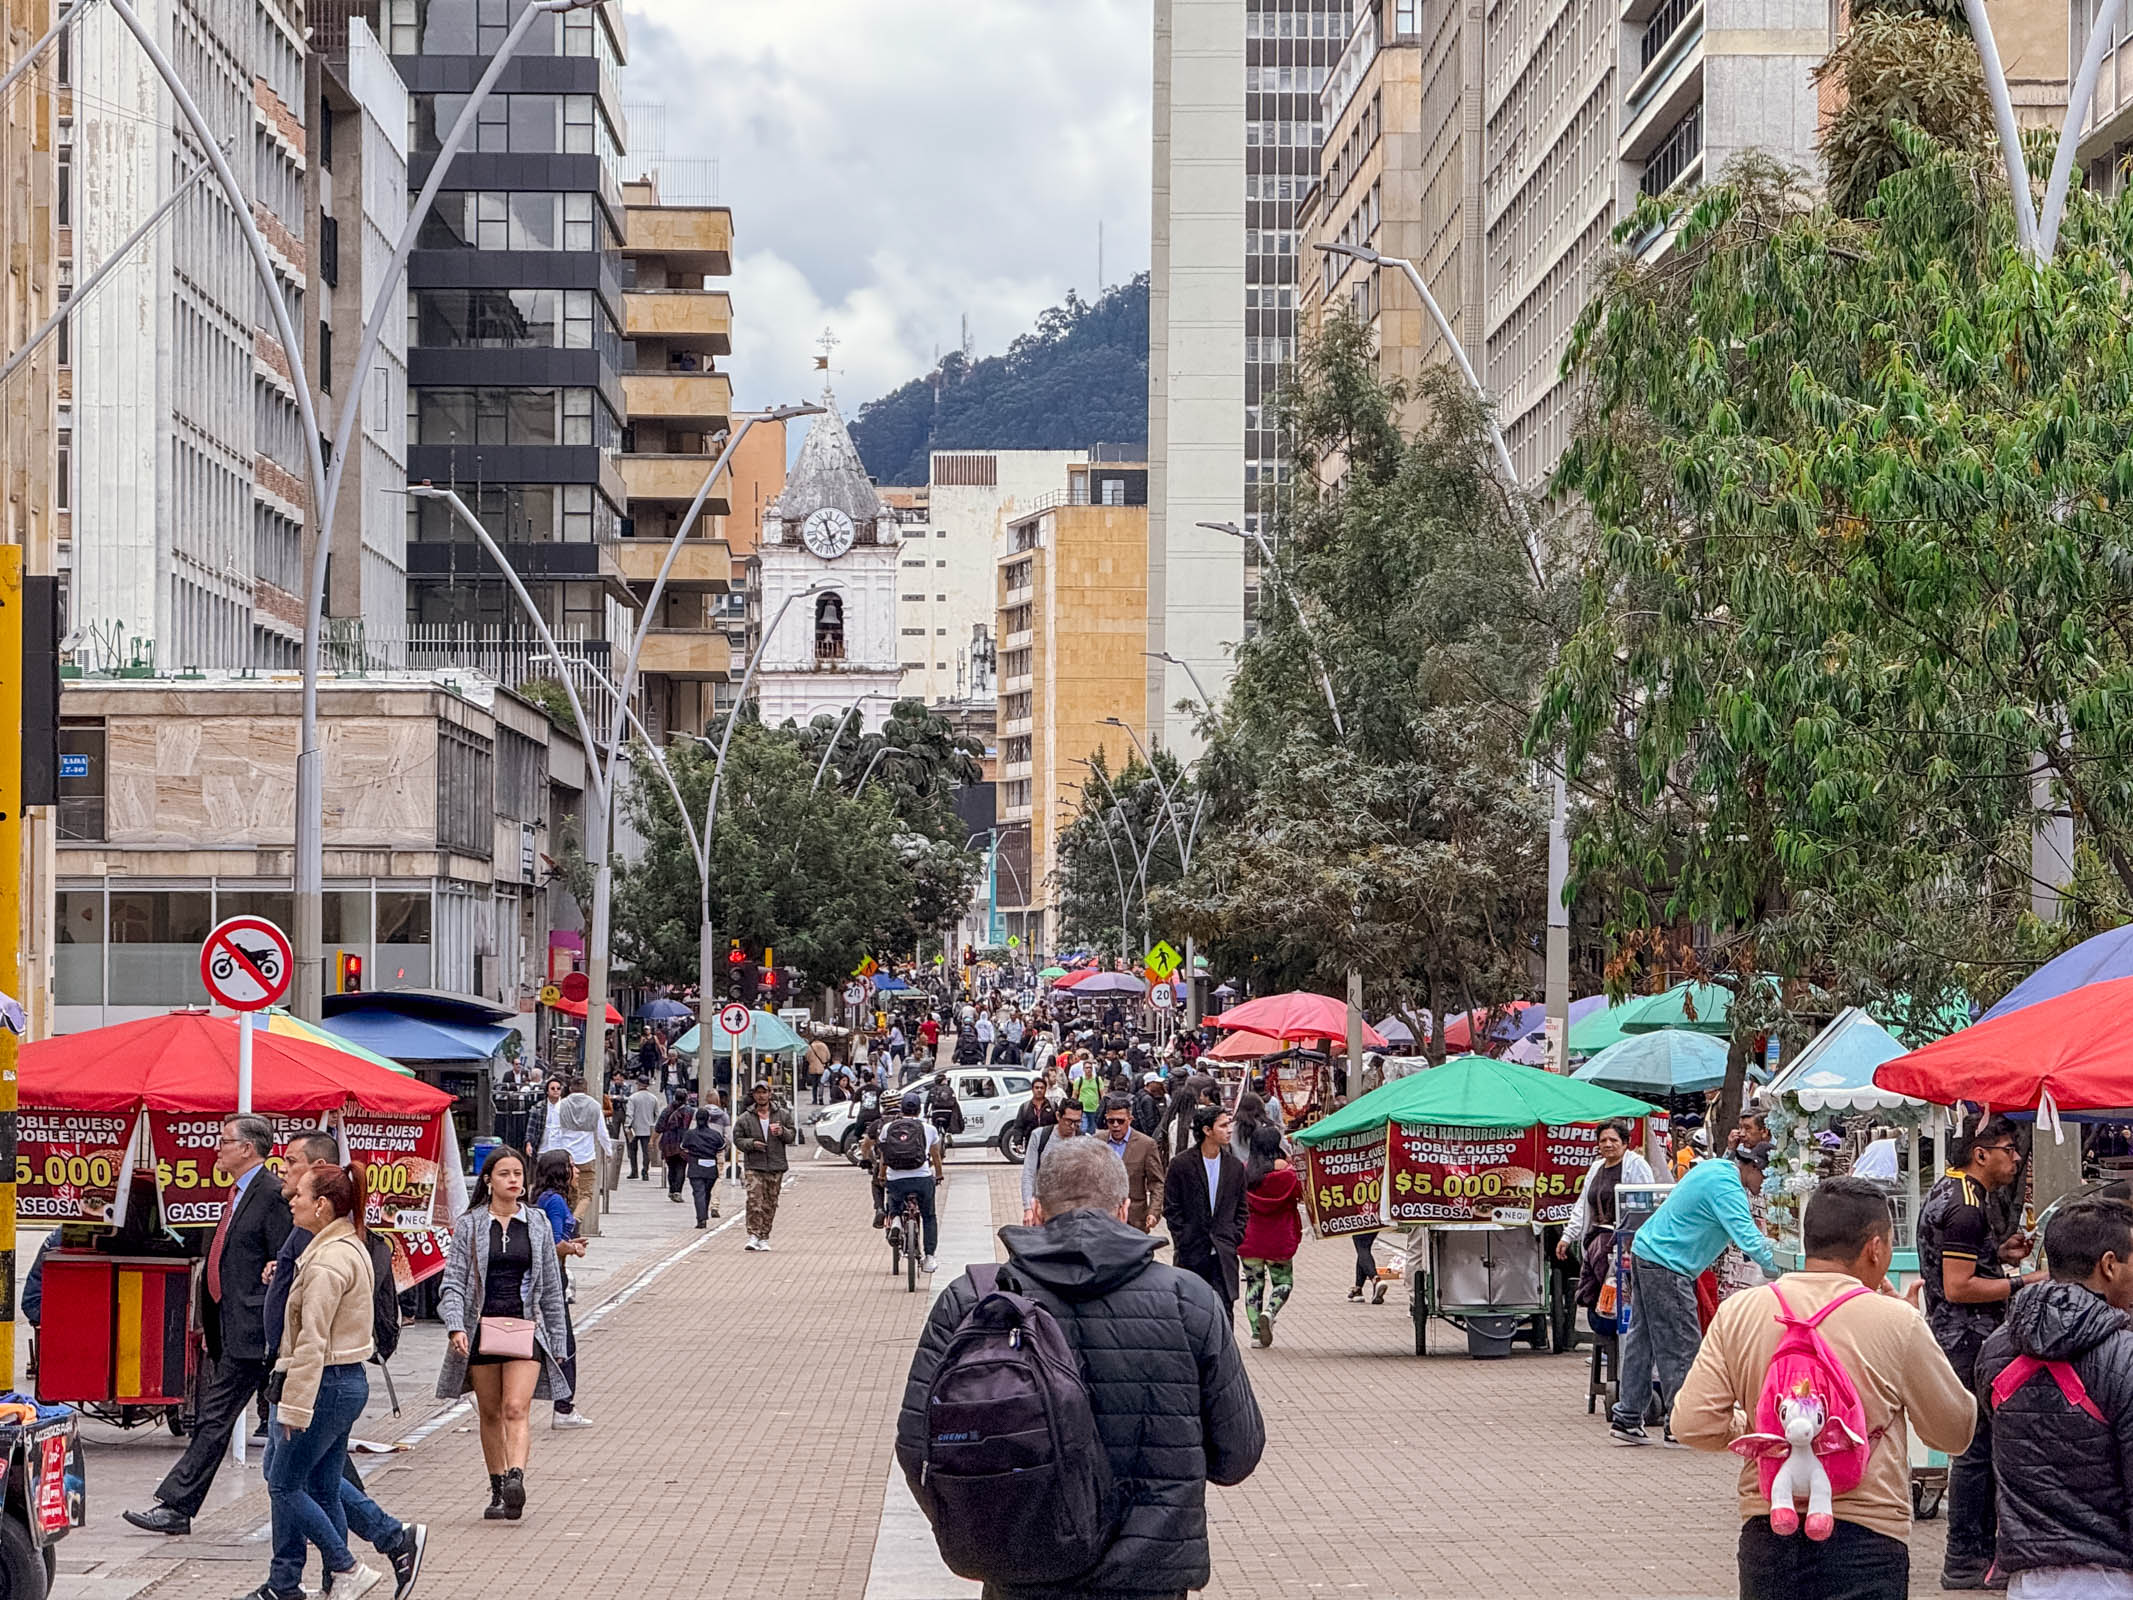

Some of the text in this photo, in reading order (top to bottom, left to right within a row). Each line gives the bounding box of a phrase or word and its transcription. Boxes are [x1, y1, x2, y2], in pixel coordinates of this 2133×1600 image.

[1156, 990, 1170, 1000] 20
[17, 1116, 126, 1131] OBLE QUESO
[74, 1131, 119, 1145] PAPA
[385, 1125, 424, 1139] QUESO
[1400, 1123, 1526, 1142] SUPER HAMBURGUESA
[388, 1138, 416, 1152] PAPA
[1316, 1137, 1349, 1153] SUPER
[1367, 1144, 1386, 1159] QUES
[1463, 1143, 1518, 1155] QUESO
[1470, 1154, 1510, 1165] PAPA
[1394, 1168, 1502, 1198] $5.000
[1535, 1171, 1587, 1199] $5.0
[1319, 1179, 1381, 1212] $5.00
[17, 1198, 82, 1215] ASEOSA
[168, 1202, 227, 1221] GASE
[1402, 1203, 1474, 1219] GASEOSA
[1548, 1205, 1575, 1221] GASE
[1329, 1213, 1379, 1233] GASEOSA
